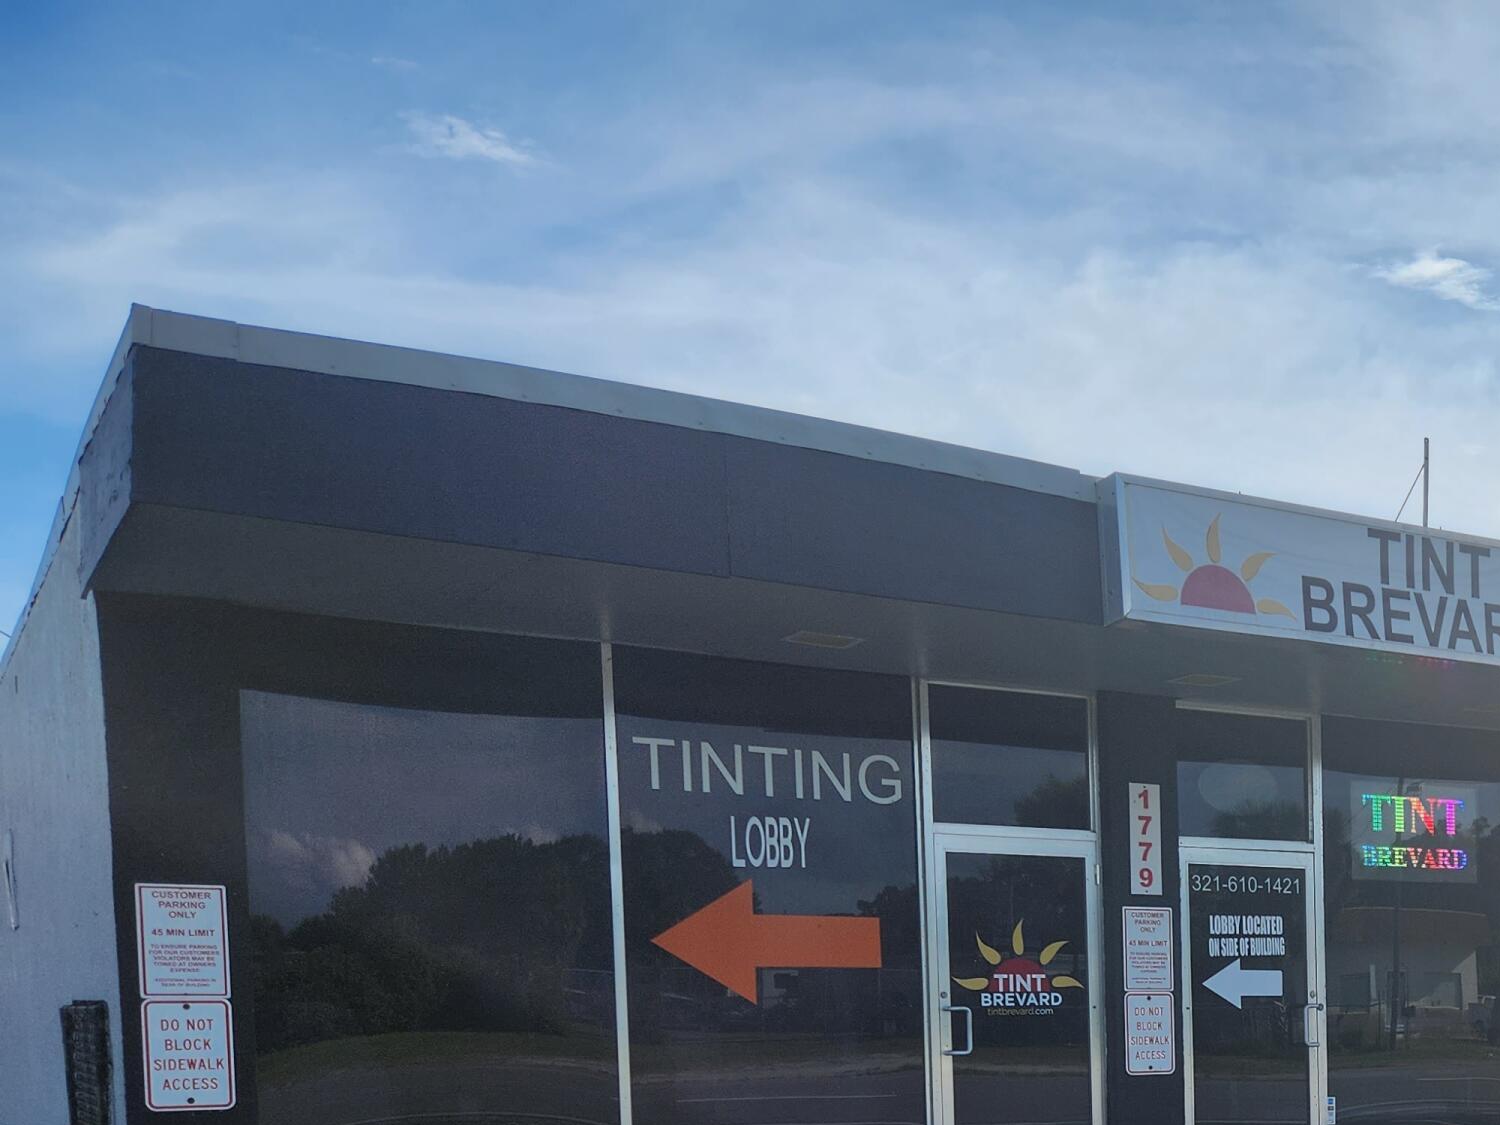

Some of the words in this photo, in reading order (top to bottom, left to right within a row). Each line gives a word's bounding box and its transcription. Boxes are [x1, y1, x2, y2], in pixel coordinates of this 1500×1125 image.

[1367, 527, 1491, 599] TINT
[632, 736, 902, 805] TINTING
[1361, 793, 1465, 836] TINT
[730, 815, 811, 868] LOBBY
[1138, 789, 1153, 888] 1779
[1362, 845, 1468, 869] BREVARD
[1191, 874, 1301, 895] 321-610-1421
[151, 890, 212, 900] CUSTOMER
[158, 901, 206, 909] PARKING
[168, 911, 197, 919] ONLY
[1209, 915, 1241, 935] LOBBY
[1242, 915, 1283, 935] LOCATED
[166, 929, 185, 937] MIN
[188, 929, 216, 937] LIMIT
[1208, 938, 1220, 957] ON
[1221, 938, 1239, 957] SIDE
[1240, 938, 1250, 956] OF
[1250, 937, 1286, 956] BUILDING
[993, 973, 1046, 992] TINT
[981, 992, 1062, 1006] BREVARD
[987, 1007, 1054, 1016] tintbrevard.com
[1135, 1007, 1146, 1016] DO
[1148, 1007, 1164, 1016] NOT
[160, 1019, 179, 1031] DO
[187, 1019, 214, 1031] NOT
[1136, 1021, 1163, 1031] BLOCK
[165, 1038, 212, 1051] BLOCK
[1131, 1036, 1170, 1046] SIDEWALK
[1136, 1051, 1166, 1060] ACCESS
[154, 1058, 225, 1071] SIDEWALK
[163, 1078, 219, 1090] ACCESS
